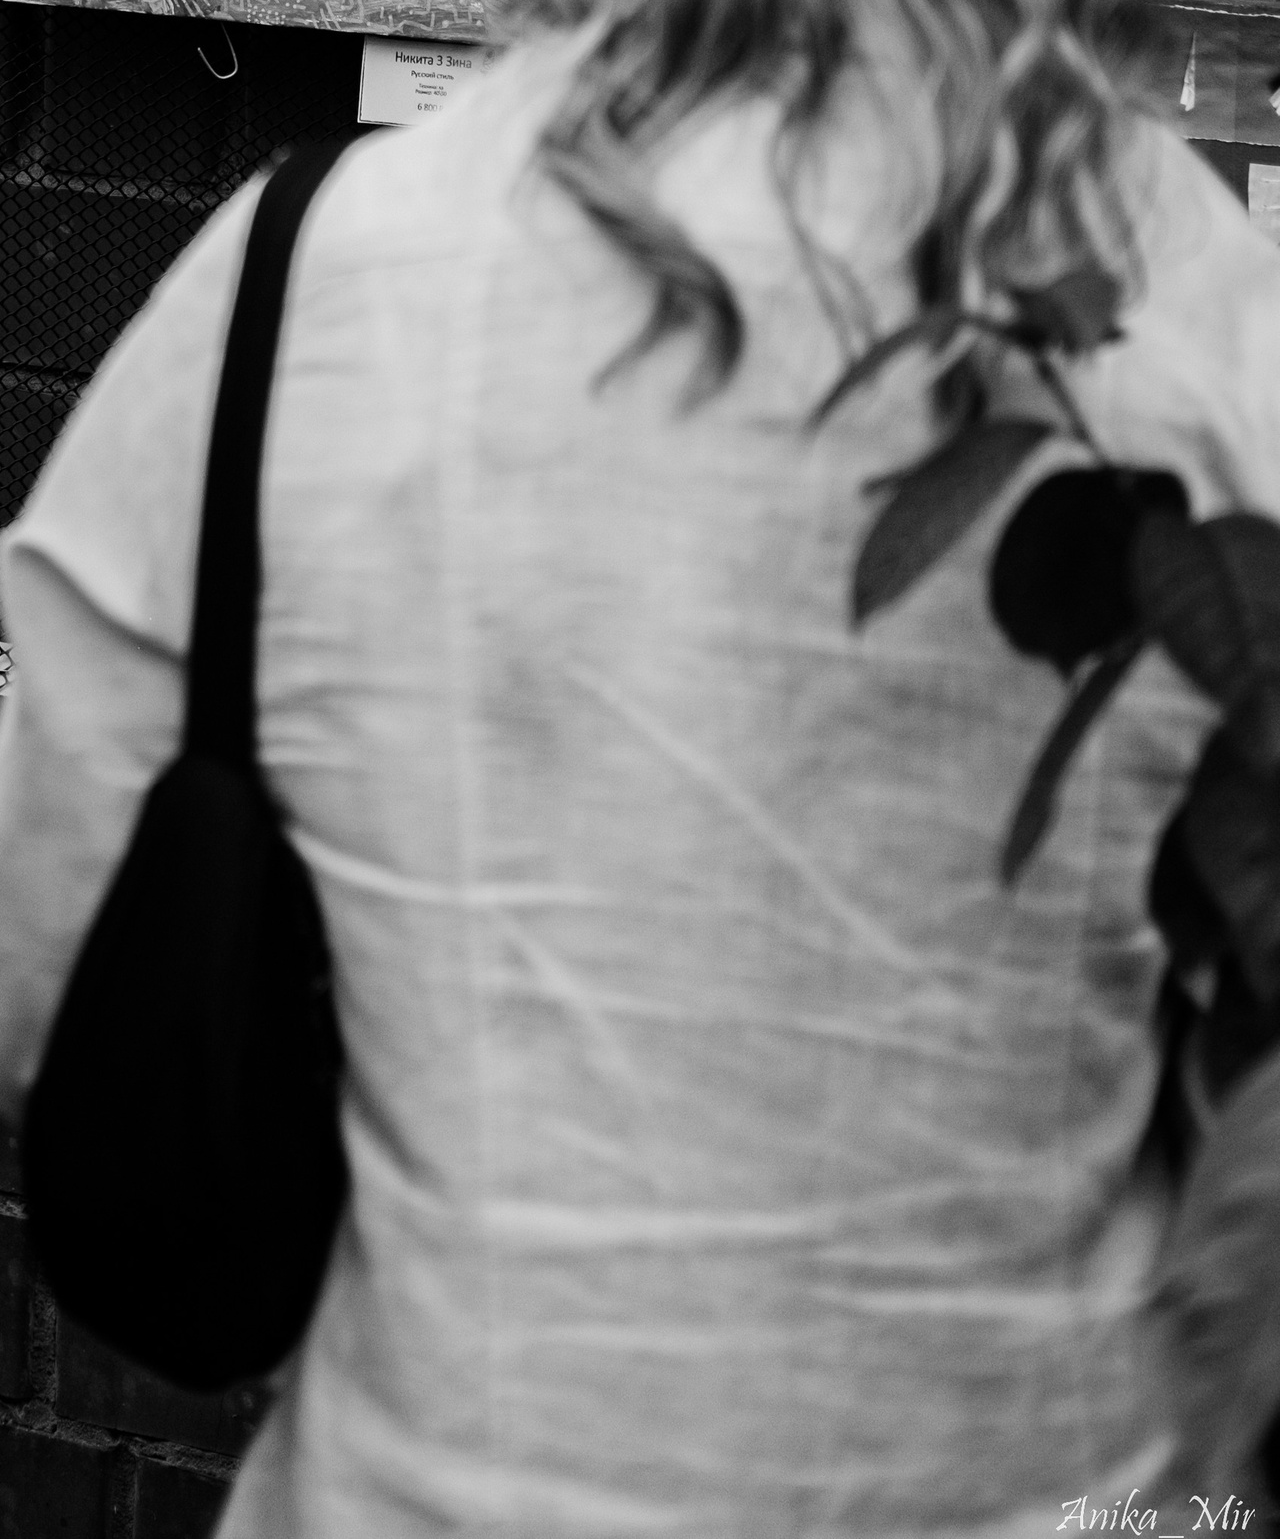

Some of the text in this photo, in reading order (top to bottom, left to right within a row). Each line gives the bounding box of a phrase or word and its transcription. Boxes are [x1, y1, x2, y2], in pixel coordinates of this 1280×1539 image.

[395, 51, 434, 66] Никита
[445, 56, 472, 69] Зина
[411, 70, 435, 78] Русский
[423, 103, 438, 112] 800
